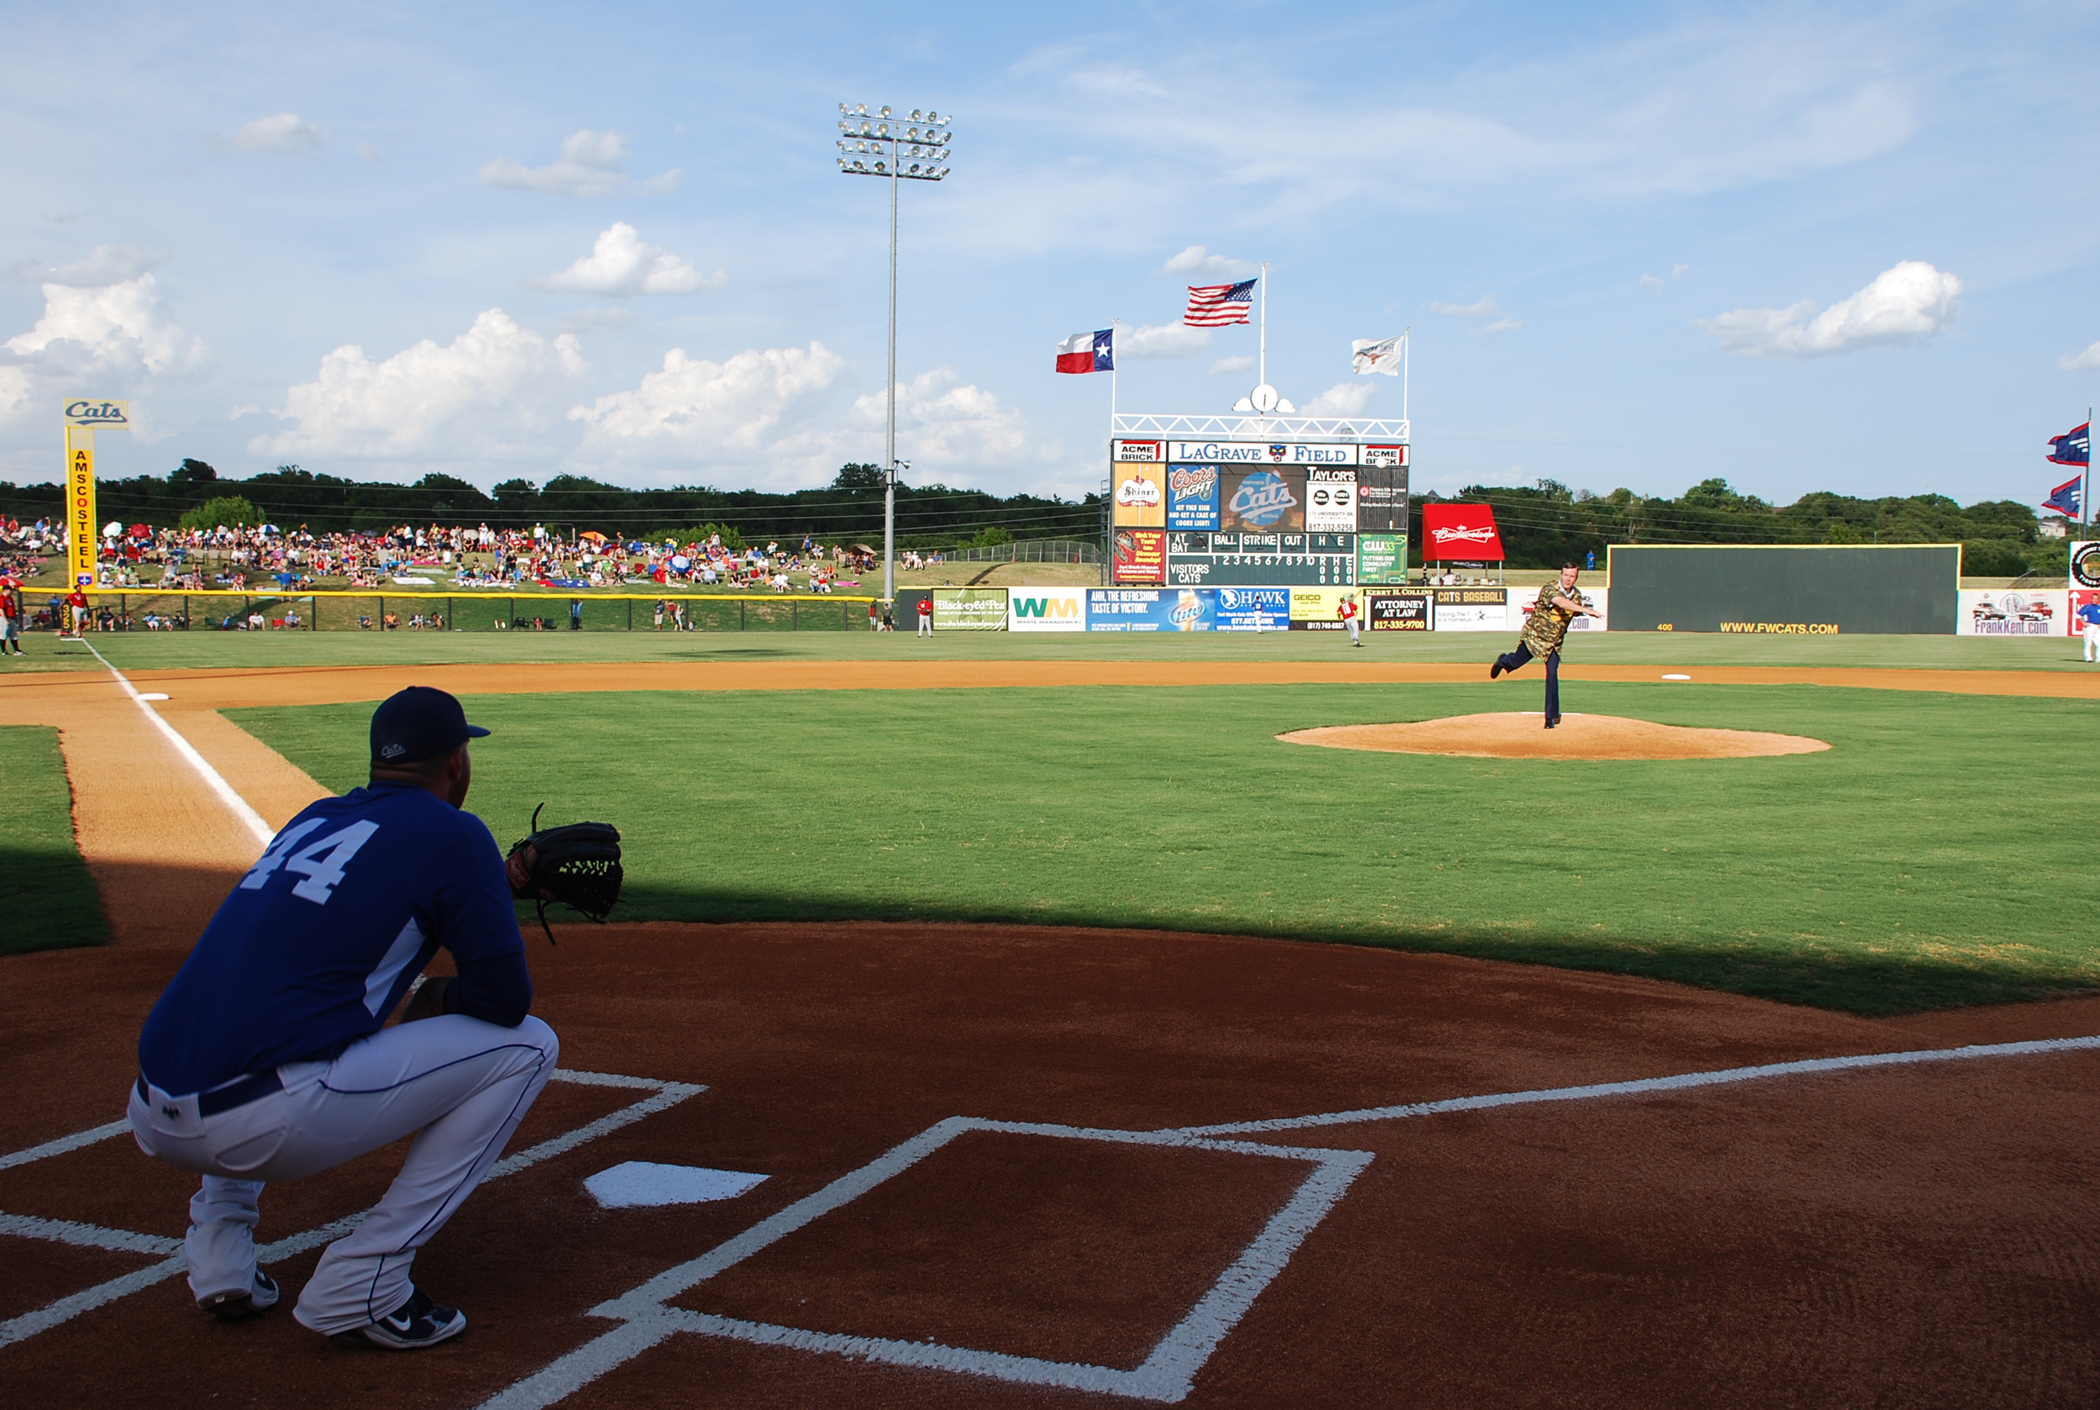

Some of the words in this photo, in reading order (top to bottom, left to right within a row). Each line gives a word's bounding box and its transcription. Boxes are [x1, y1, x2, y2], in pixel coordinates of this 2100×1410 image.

[65, 401, 128, 426] Cats
[1169, 465, 1217, 491] Coors
[1124, 486, 1155, 497] Shiner
[1228, 482, 1298, 520] Cats
[1174, 534, 1186, 543] AT
[1432, 529, 1495, 540] Budweiser
[1214, 535, 1237, 545] BALL
[1243, 535, 1277, 545] STRIKE
[1284, 535, 1302, 546] OUT
[1319, 536, 1326, 546] H
[1337, 536, 1344, 546] E
[1171, 543, 1189, 553] BAT
[1212, 556, 1217, 565] 1
[1223, 556, 1230, 565] 2
[1233, 556, 1240, 565] 3
[1244, 556, 1251, 565] 4
[1254, 556, 1261, 565] 5
[1265, 556, 1271, 565] 6
[1275, 556, 1282, 565] 7
[1286, 556, 1292, 565] 8
[1296, 557, 1303, 566] 9
[1320, 557, 1326, 566] R
[1333, 557, 1340, 566] H
[1346, 557, 1352, 566] E
[1170, 564, 1210, 574] VISITORS
[1320, 566, 1326, 575] 0
[1333, 566, 1340, 575] 0
[1346, 566, 1352, 575] 0
[1178, 573, 1201, 583] CATS
[1320, 575, 1326, 584] 0
[1333, 575, 1340, 584] 0
[1346, 575, 1352, 584] 0
[1091, 591, 1106, 602] AHH,
[1107, 591, 1119, 601] THE
[1120, 591, 1159, 602] REFRESHING
[1240, 591, 1286, 604] HAWK
[1437, 591, 1460, 602] CATS
[1463, 592, 1505, 602] BASEBALL
[1091, 603, 1110, 613] TASTE
[1111, 603, 1120, 613] OF
[1120, 603, 1148, 613] VICTORY.
[1374, 600, 1425, 609] ATTORNEY
[1382, 609, 1394, 617] AT
[1396, 609, 1417, 617] LAW
[1373, 621, 1425, 629] 817-335-9700
[1657, 623, 1673, 631] 400
[1720, 622, 1839, 634] WWW.FWCATS.COM
[1975, 619, 2048, 634] FrankKent.com
[381, 743, 406, 759] Cats
[239, 817, 380, 906] 44
